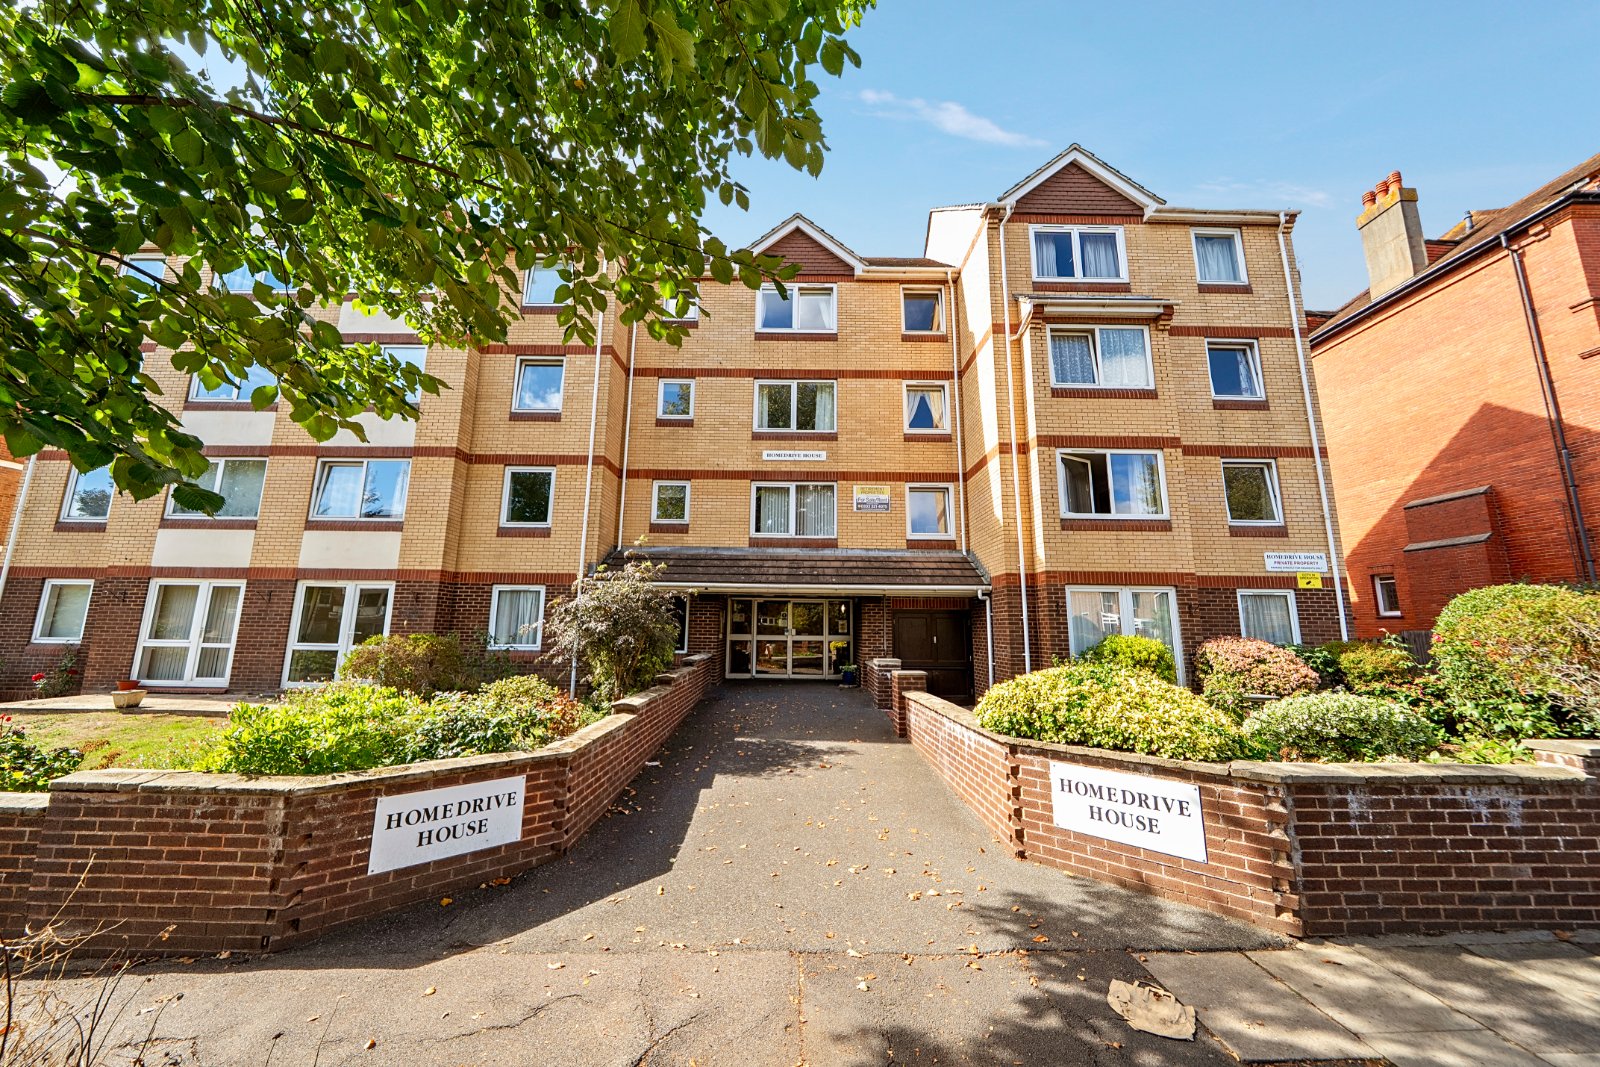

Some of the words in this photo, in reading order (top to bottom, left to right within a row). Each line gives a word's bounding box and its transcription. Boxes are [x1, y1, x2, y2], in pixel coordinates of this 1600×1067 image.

[385, 791, 517, 830] HOMEDRIVE
[1059, 778, 1191, 817] HOMEDRIVE
[416, 818, 488, 847] HOUSE
[1088, 805, 1161, 834] HOUSE
